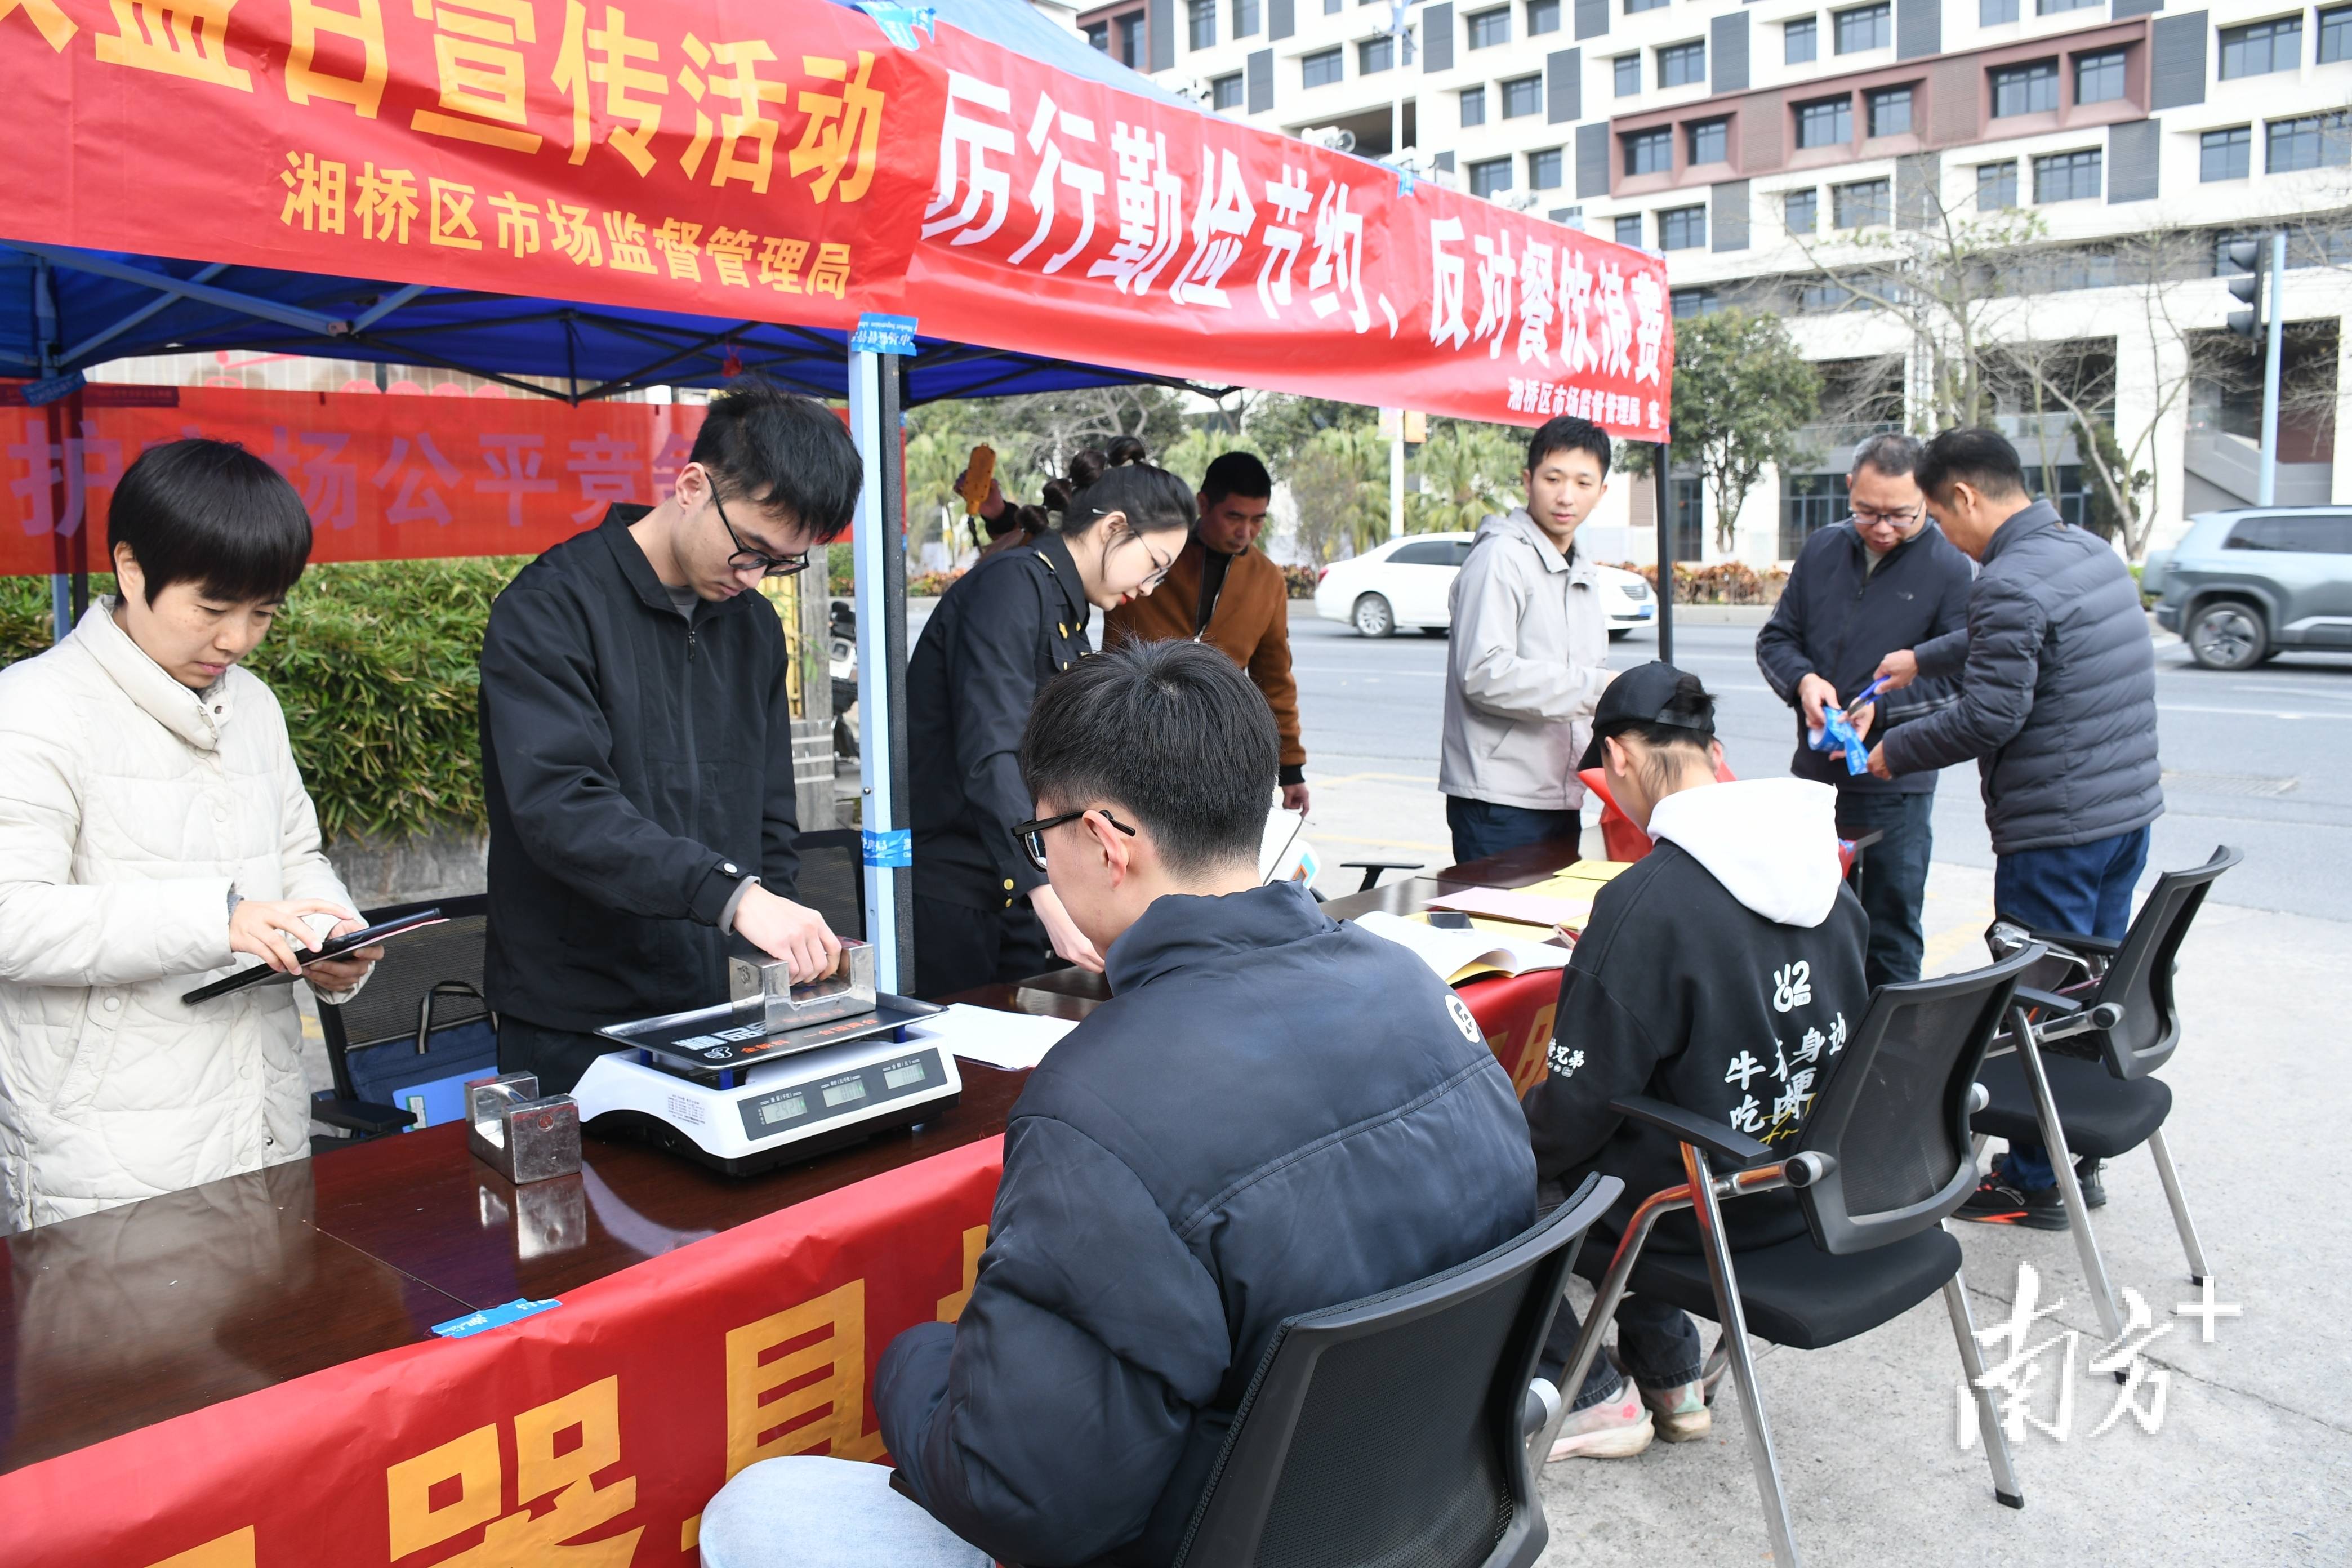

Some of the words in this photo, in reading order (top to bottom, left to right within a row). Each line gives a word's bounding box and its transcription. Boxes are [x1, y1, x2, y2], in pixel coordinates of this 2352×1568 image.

[0, 0, 887, 204] 日宣传活动
[280, 149, 851, 300] 湘桥区市场监督管理局
[920, 68, 1665, 386] 厉行勤俭节约、反对餐饮浪费
[1507, 377, 1641, 427] 湘桥区市场监督管理局
[6, 420, 702, 538] 护场公平竞
